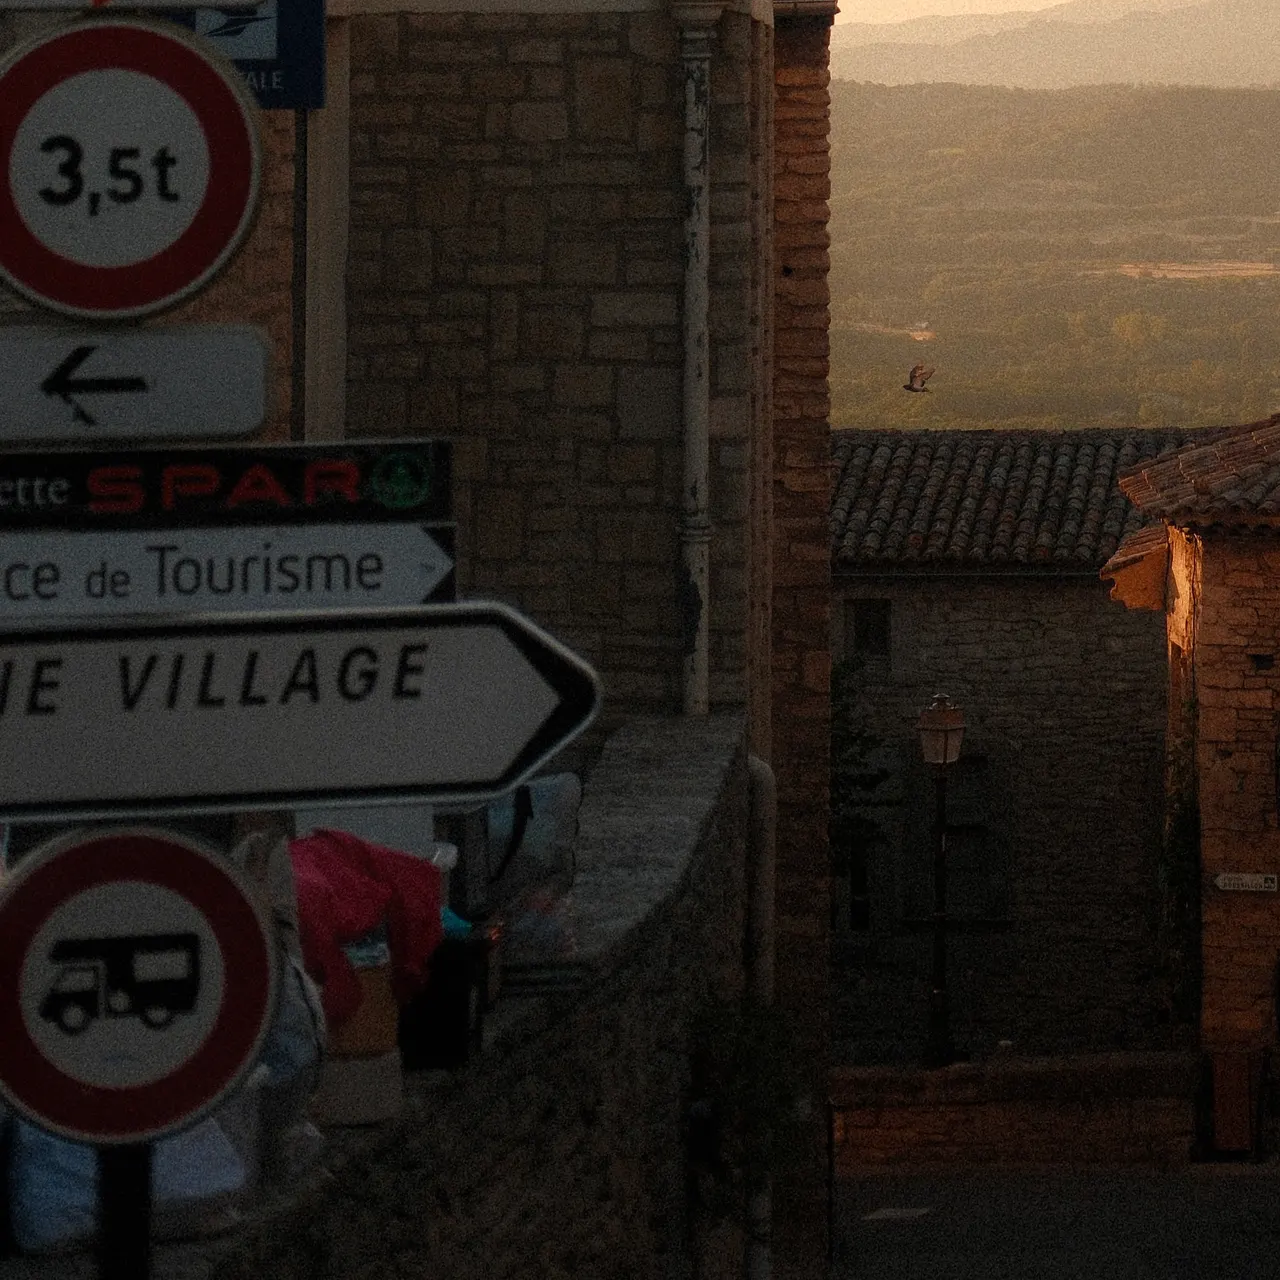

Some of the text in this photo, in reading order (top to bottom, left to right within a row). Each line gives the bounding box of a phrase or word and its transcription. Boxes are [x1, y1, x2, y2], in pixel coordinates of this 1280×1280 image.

[39, 134, 180, 217] 3,5t
[86, 457, 362, 515] SPAR
[4, 543, 385, 601] ce de Tourisme
[118, 643, 429, 711] VILLAGE
